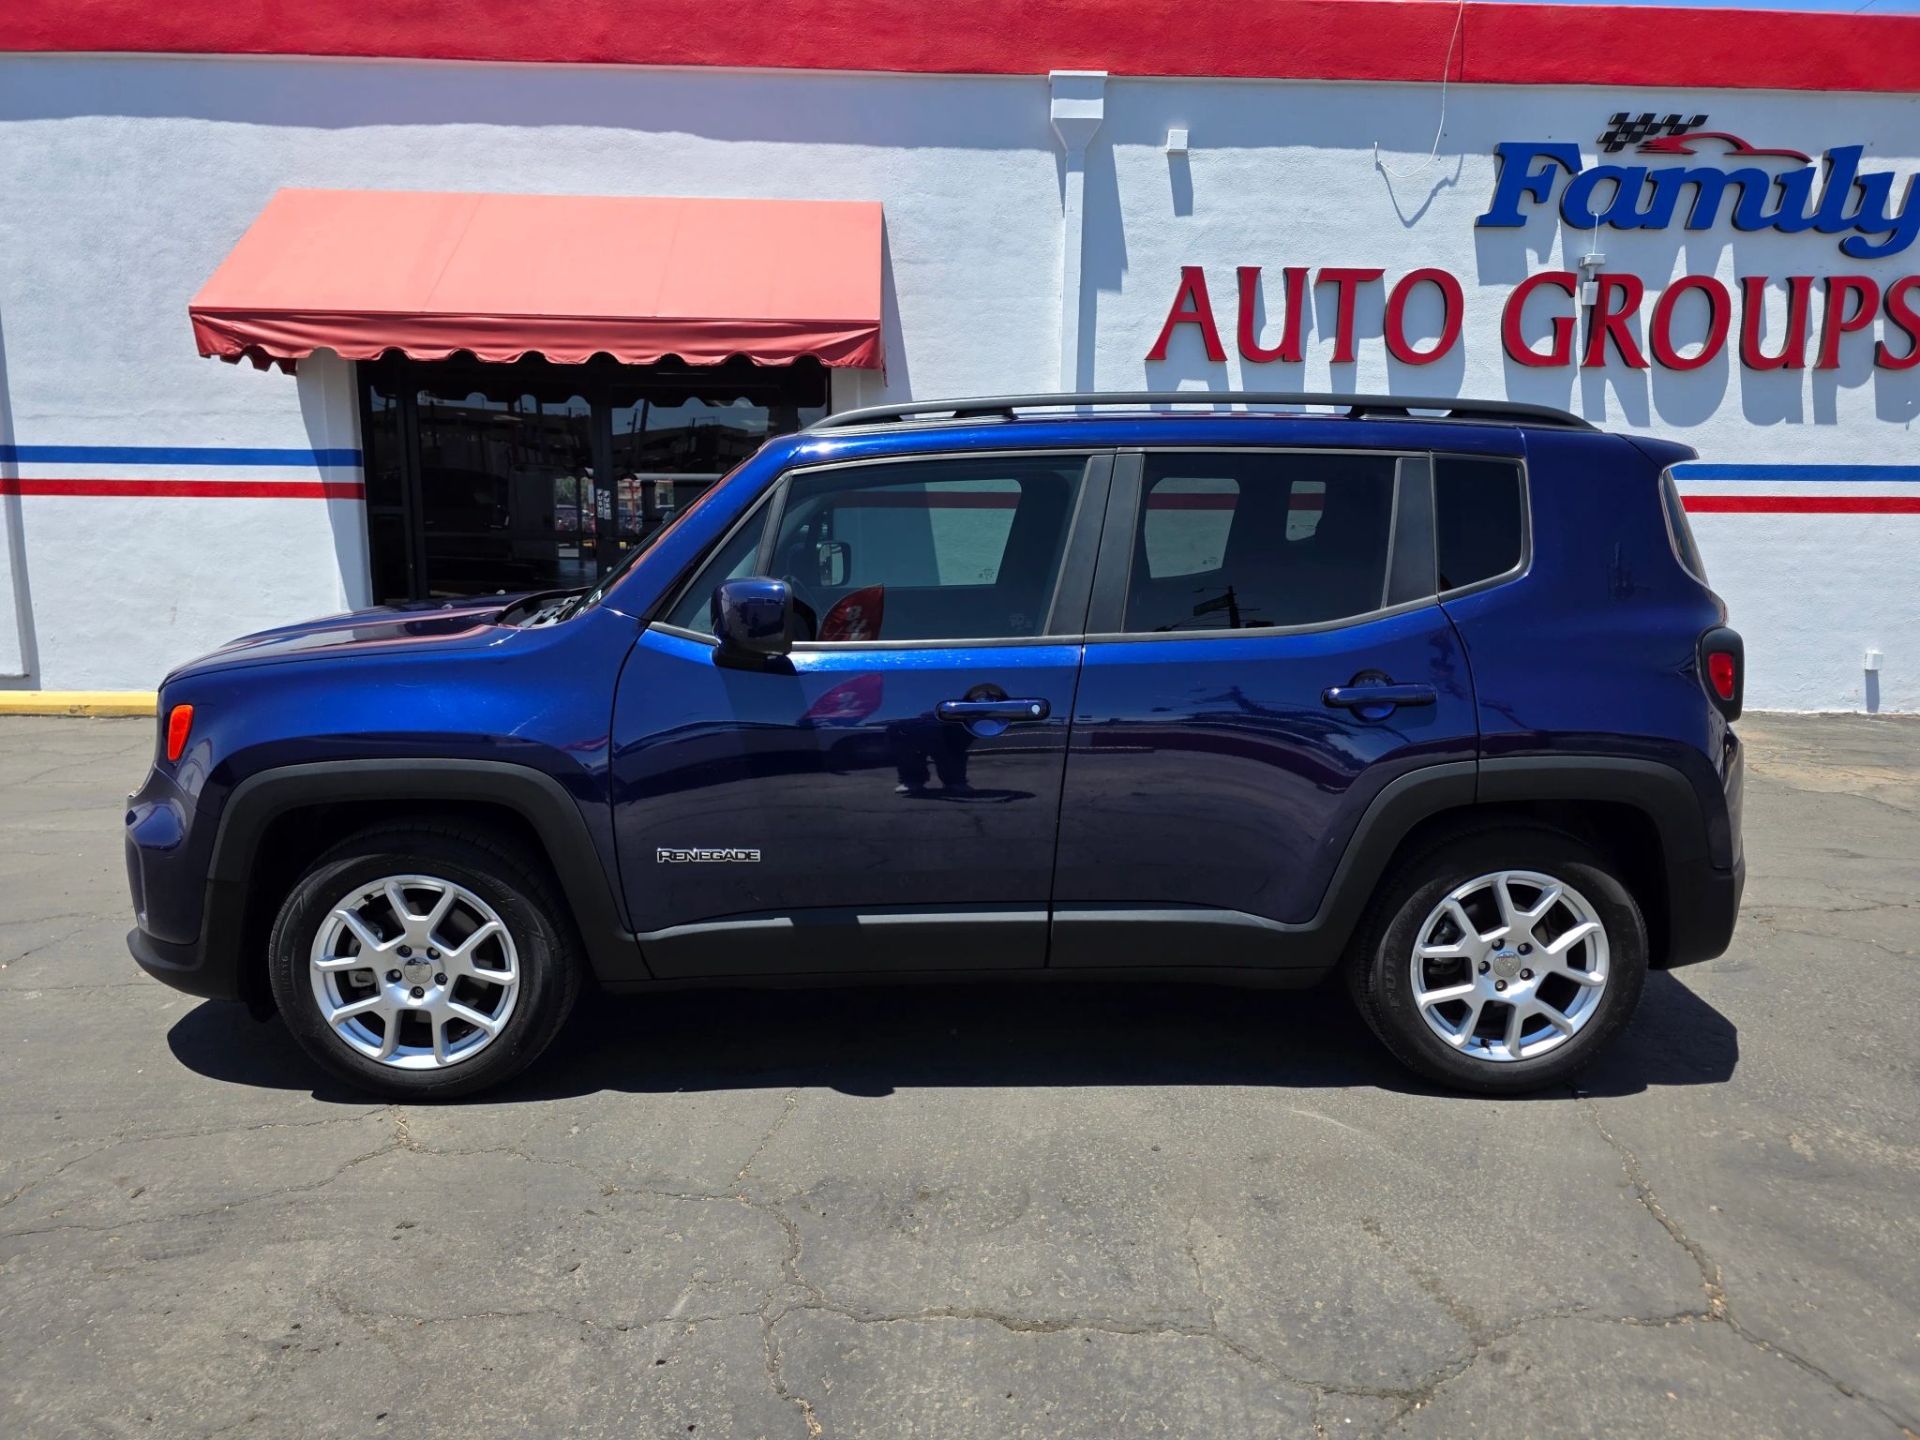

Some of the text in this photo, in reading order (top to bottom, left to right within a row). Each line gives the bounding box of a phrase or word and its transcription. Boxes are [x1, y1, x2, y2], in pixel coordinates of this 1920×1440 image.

[1475, 141, 1920, 259] Family
[1145, 266, 1920, 370] AUTO GROUPS
[657, 847, 761, 863] RENEGADE
